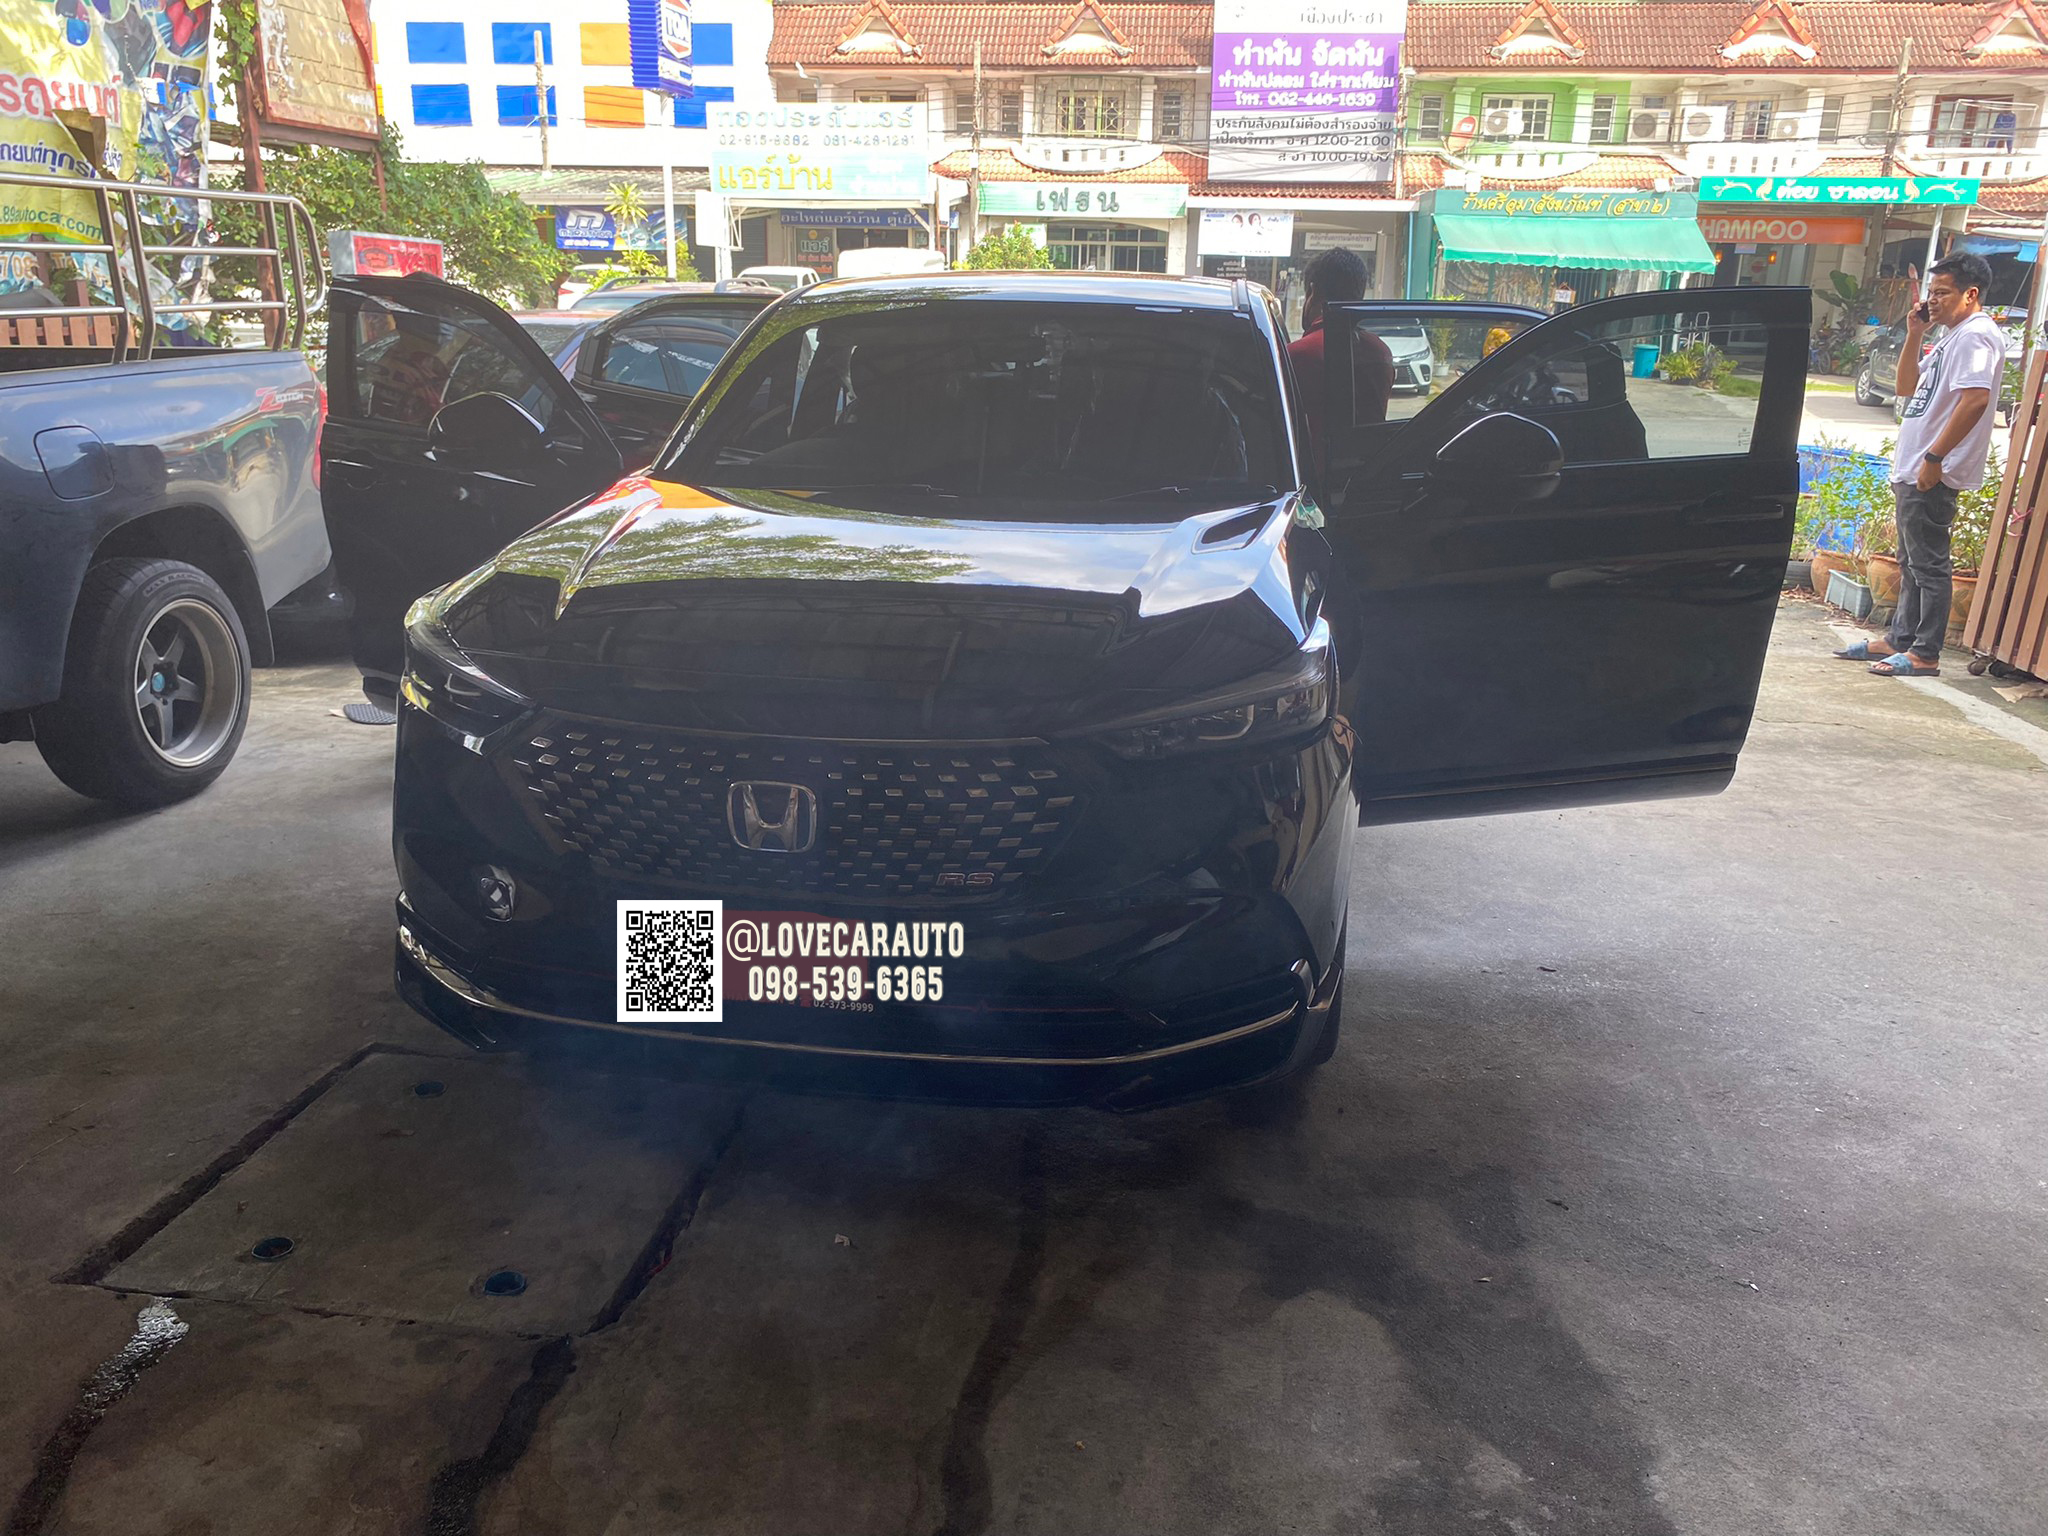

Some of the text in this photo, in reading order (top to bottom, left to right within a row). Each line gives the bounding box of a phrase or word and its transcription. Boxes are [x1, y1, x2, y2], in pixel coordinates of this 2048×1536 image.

[1232, 38, 1385, 67] ทำฟัน จัดฟัน
[1218, 69, 1305, 88] ทำฟันปลอม
[718, 153, 834, 190] แอร์บ้าน
[1697, 217, 1807, 241] HAMPOO
[935, 871, 995, 887] RS
[813, 999, 874, 1012] 02-373-9999
